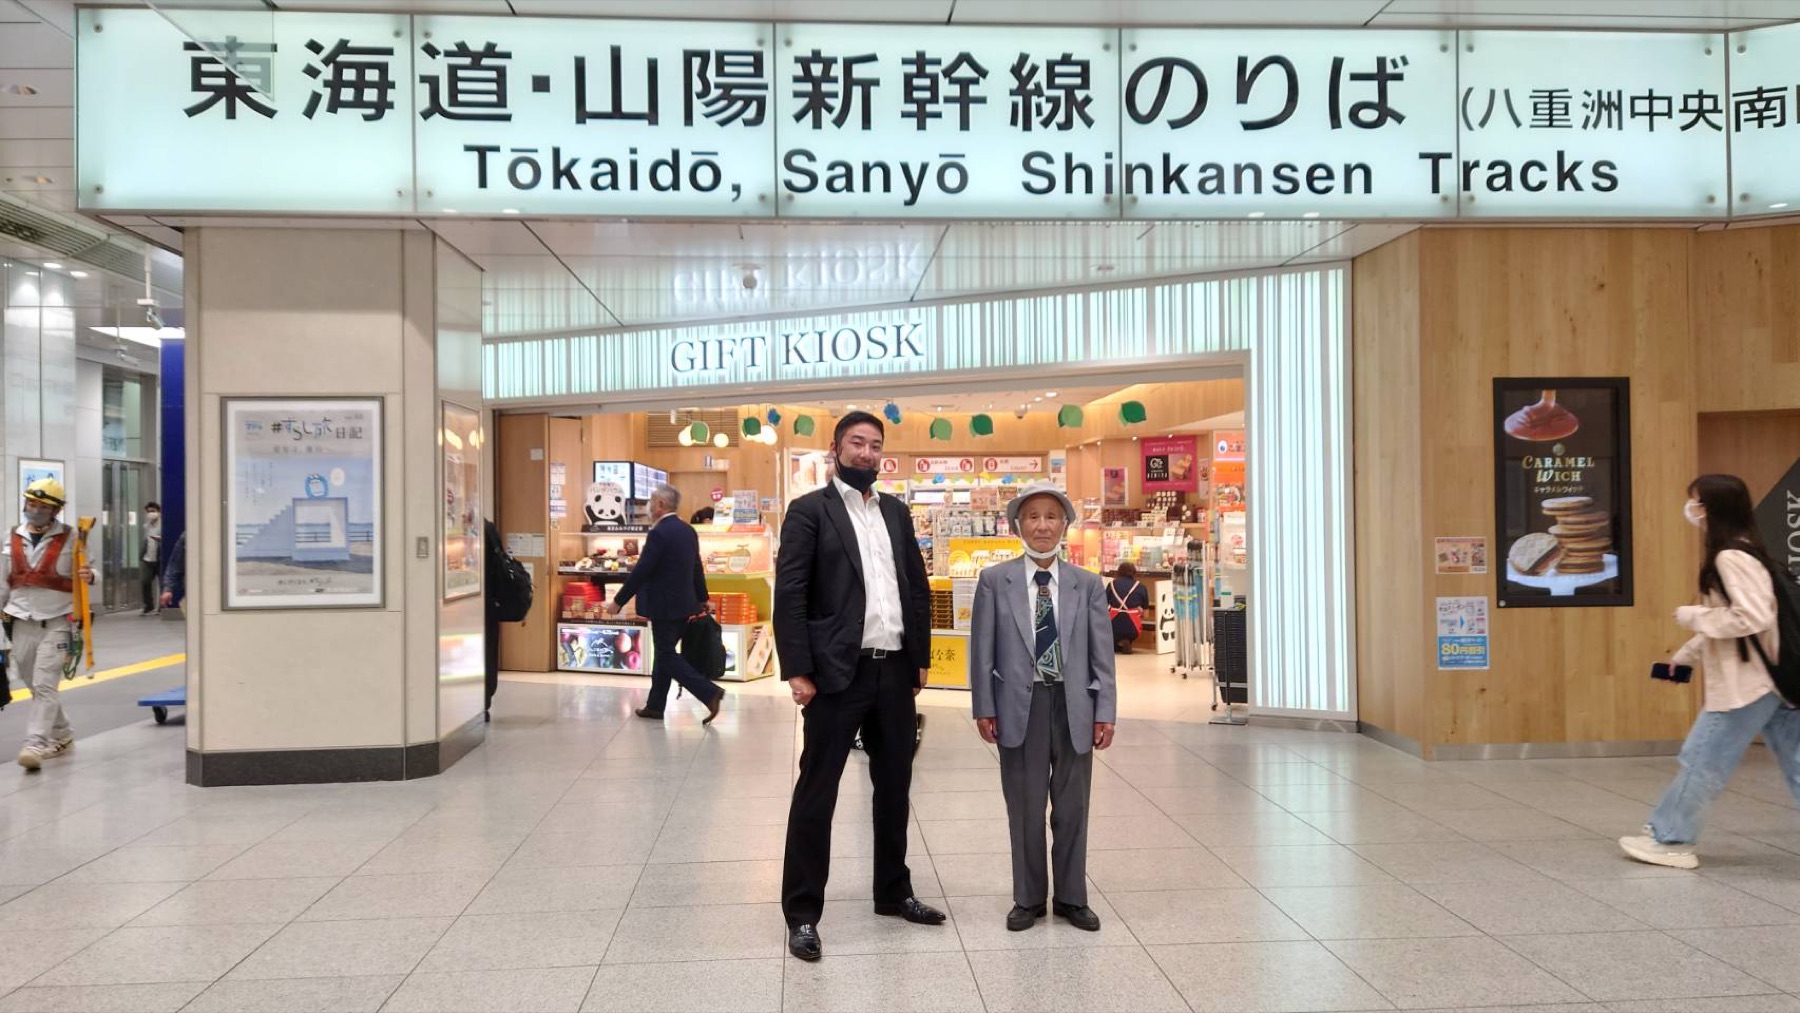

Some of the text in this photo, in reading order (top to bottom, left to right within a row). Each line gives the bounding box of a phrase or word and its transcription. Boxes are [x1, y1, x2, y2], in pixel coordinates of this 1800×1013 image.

[1461, 85, 1800, 132] (八重洲中央南
[463, 144, 1619, 206] Tōkaidō, Sanyō Shinkansen Tracks
[671, 322, 924, 373] GIFT KIOSK
[1522, 455, 1595, 469] CARAMEL
[1536, 469, 1582, 483] WICH
